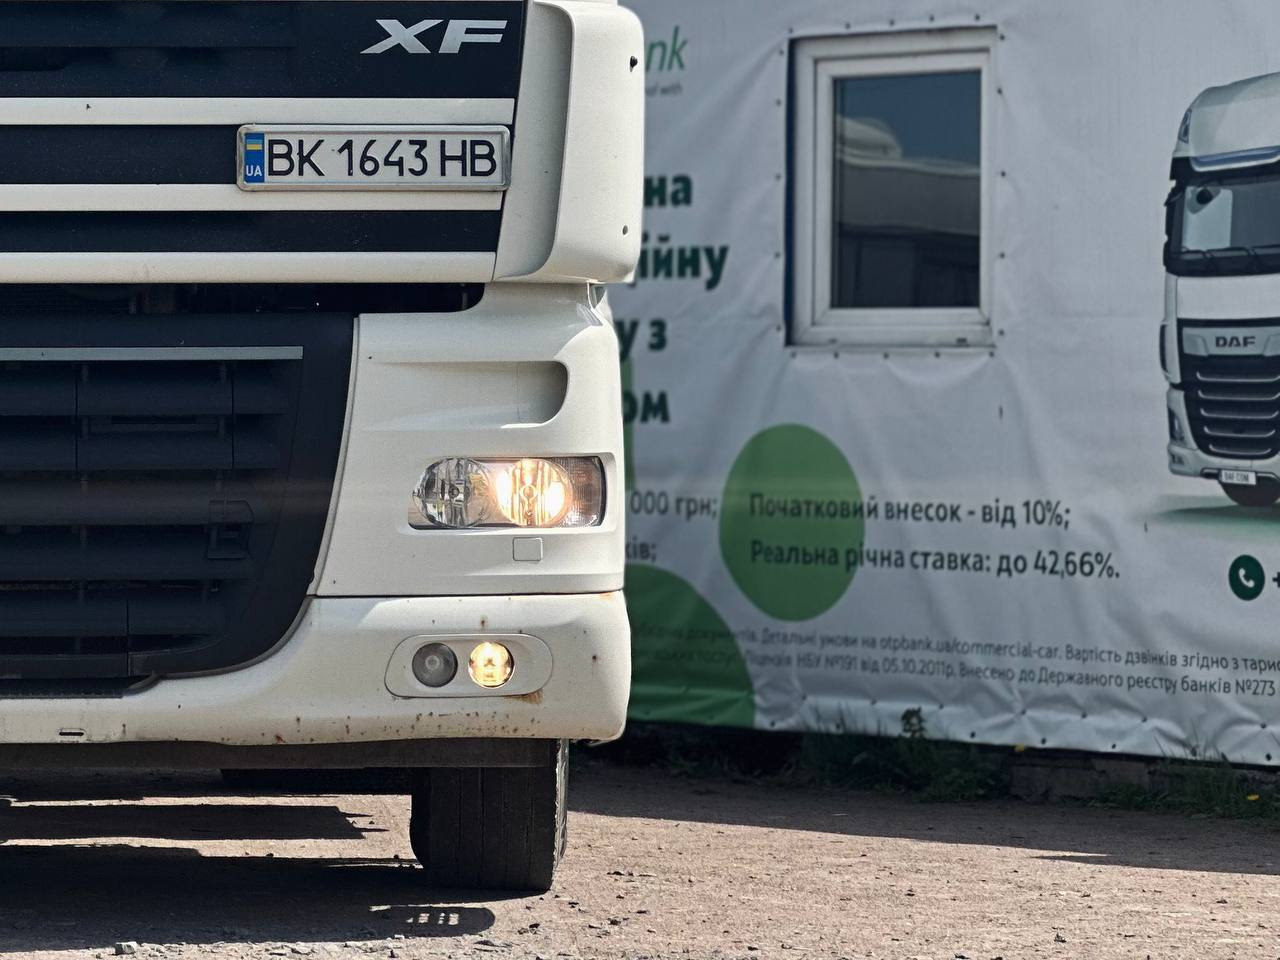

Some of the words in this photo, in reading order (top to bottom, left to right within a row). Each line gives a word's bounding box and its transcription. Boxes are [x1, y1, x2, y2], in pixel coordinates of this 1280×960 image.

[359, 19, 508, 54] XF
[245, 165, 263, 178] UA
[268, 138, 325, 177] BK
[337, 139, 428, 177] 1643
[439, 139, 497, 177] HB
[1215, 335, 1256, 348] DAF
[630, 490, 668, 515] 000
[674, 496, 718, 521] грн;
[749, 492, 879, 520] Початковий
[884, 501, 961, 523] внесок
[981, 498, 1017, 528] від
[1022, 499, 1071, 531] 10%;
[751, 540, 839, 566] Реальна
[845, 542, 905, 573] річна
[909, 549, 991, 573] ставка:
[996, 553, 1027, 578] до
[1033, 549, 1120, 580] 42,66%.
[1065, 643, 1122, 664] Вартість
[1125, 650, 1178, 667] дзвінків
[1181, 652, 1229, 671] згідно
[959, 661, 1015, 681] Внесено
[1019, 668, 1036, 683] до
[1037, 665, 1124, 688] Державного
[1127, 675, 1178, 695] реєстру
[1181, 674, 1231, 694] банків
[1235, 679, 1276, 697] №273
